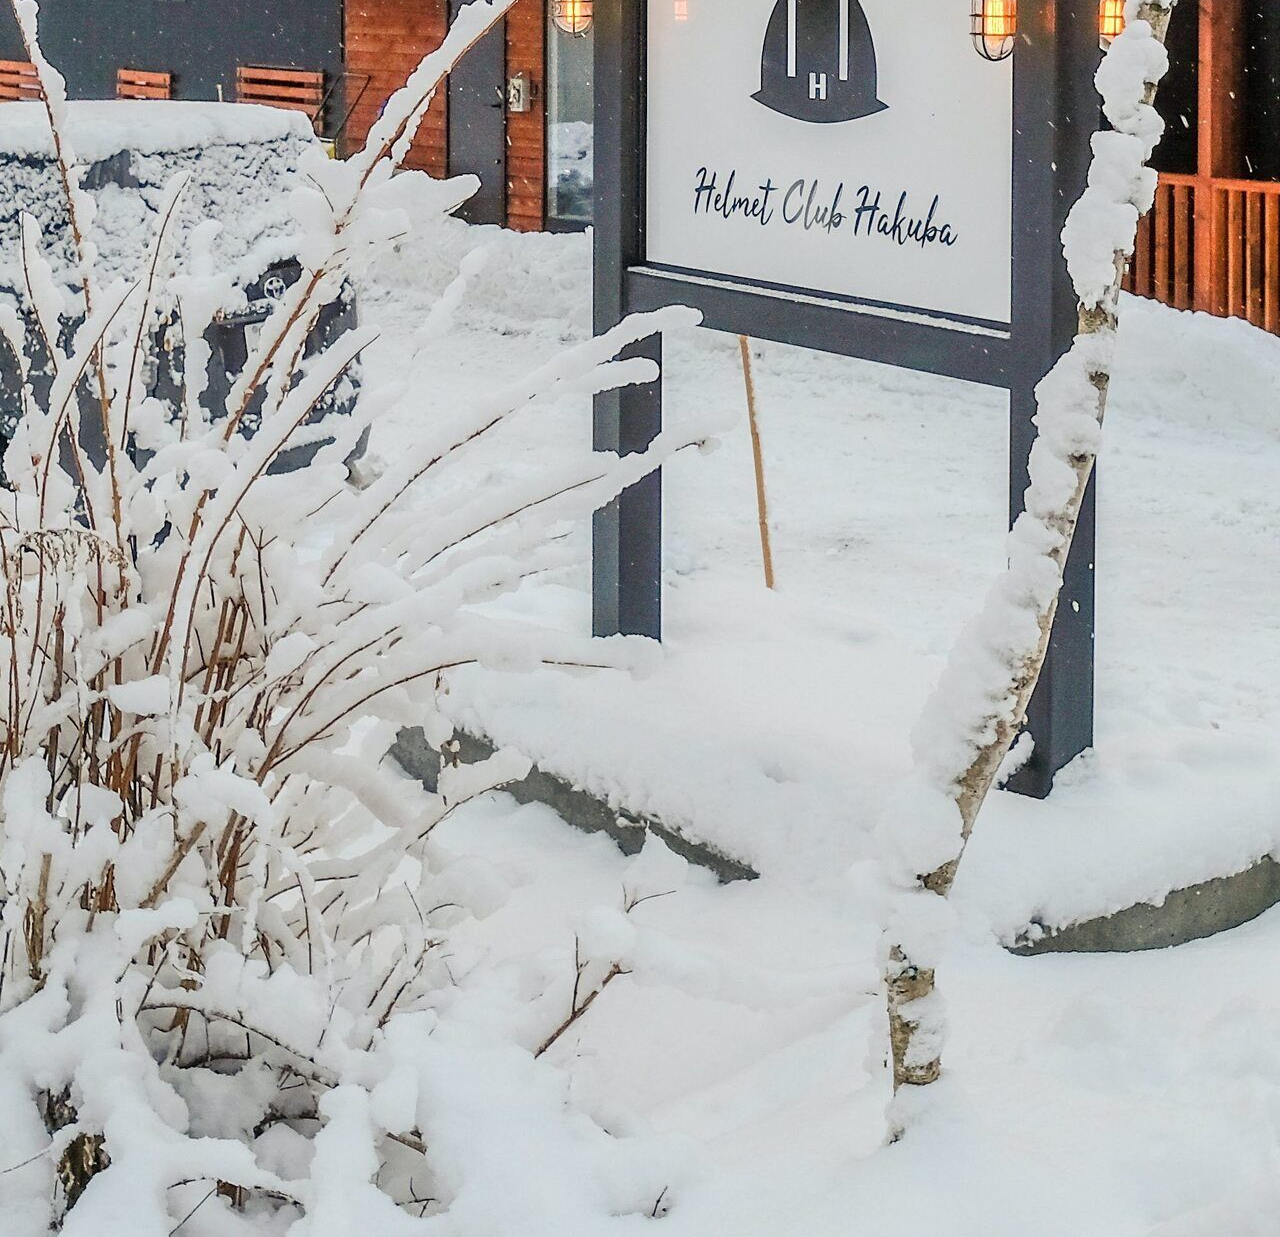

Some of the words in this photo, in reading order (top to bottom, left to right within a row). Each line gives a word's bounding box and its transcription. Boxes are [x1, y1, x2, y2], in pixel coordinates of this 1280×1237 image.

[808, 72, 827, 100] H
[694, 166, 778, 225] Helmet
[782, 179, 847, 234] Club
[854, 185, 959, 248] Hakuba
